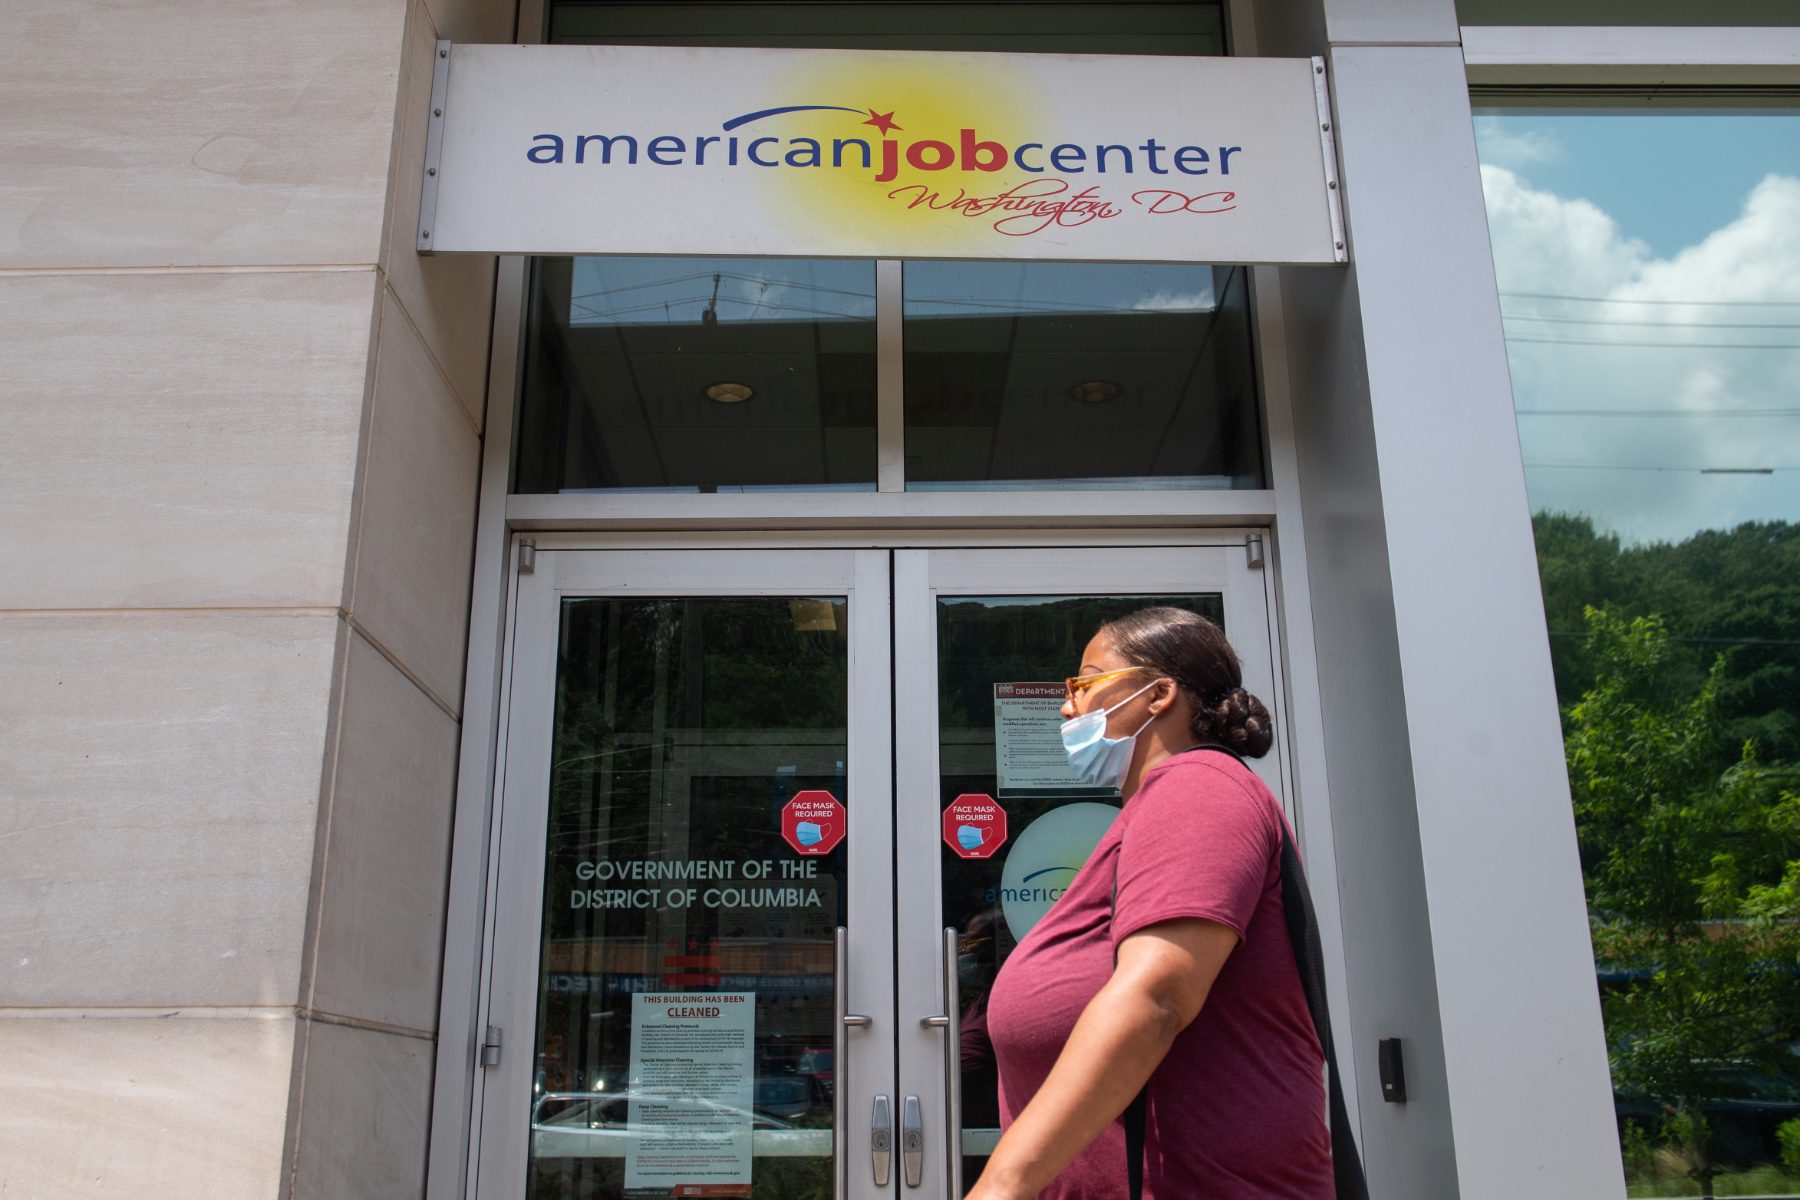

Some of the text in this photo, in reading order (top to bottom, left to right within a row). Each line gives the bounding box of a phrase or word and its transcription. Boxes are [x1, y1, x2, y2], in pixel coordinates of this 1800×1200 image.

[526, 128, 1242, 183] americanjobcenter
[1131, 190, 1237, 214] DC
[792, 802, 835, 810] FACE MASK
[795, 810, 833, 818] REQUIRED
[955, 814, 994, 822] REQUIRED
[575, 859, 817, 881] GOVERNMENT OF THE
[570, 889, 661, 909] DISTRICT
[666, 888, 697, 908] OF
[703, 888, 822, 908] COLUMBIA
[643, 995, 745, 1003] THIS BUILDING HAS BEEN
[667, 1007, 720, 1017] CLEANED
